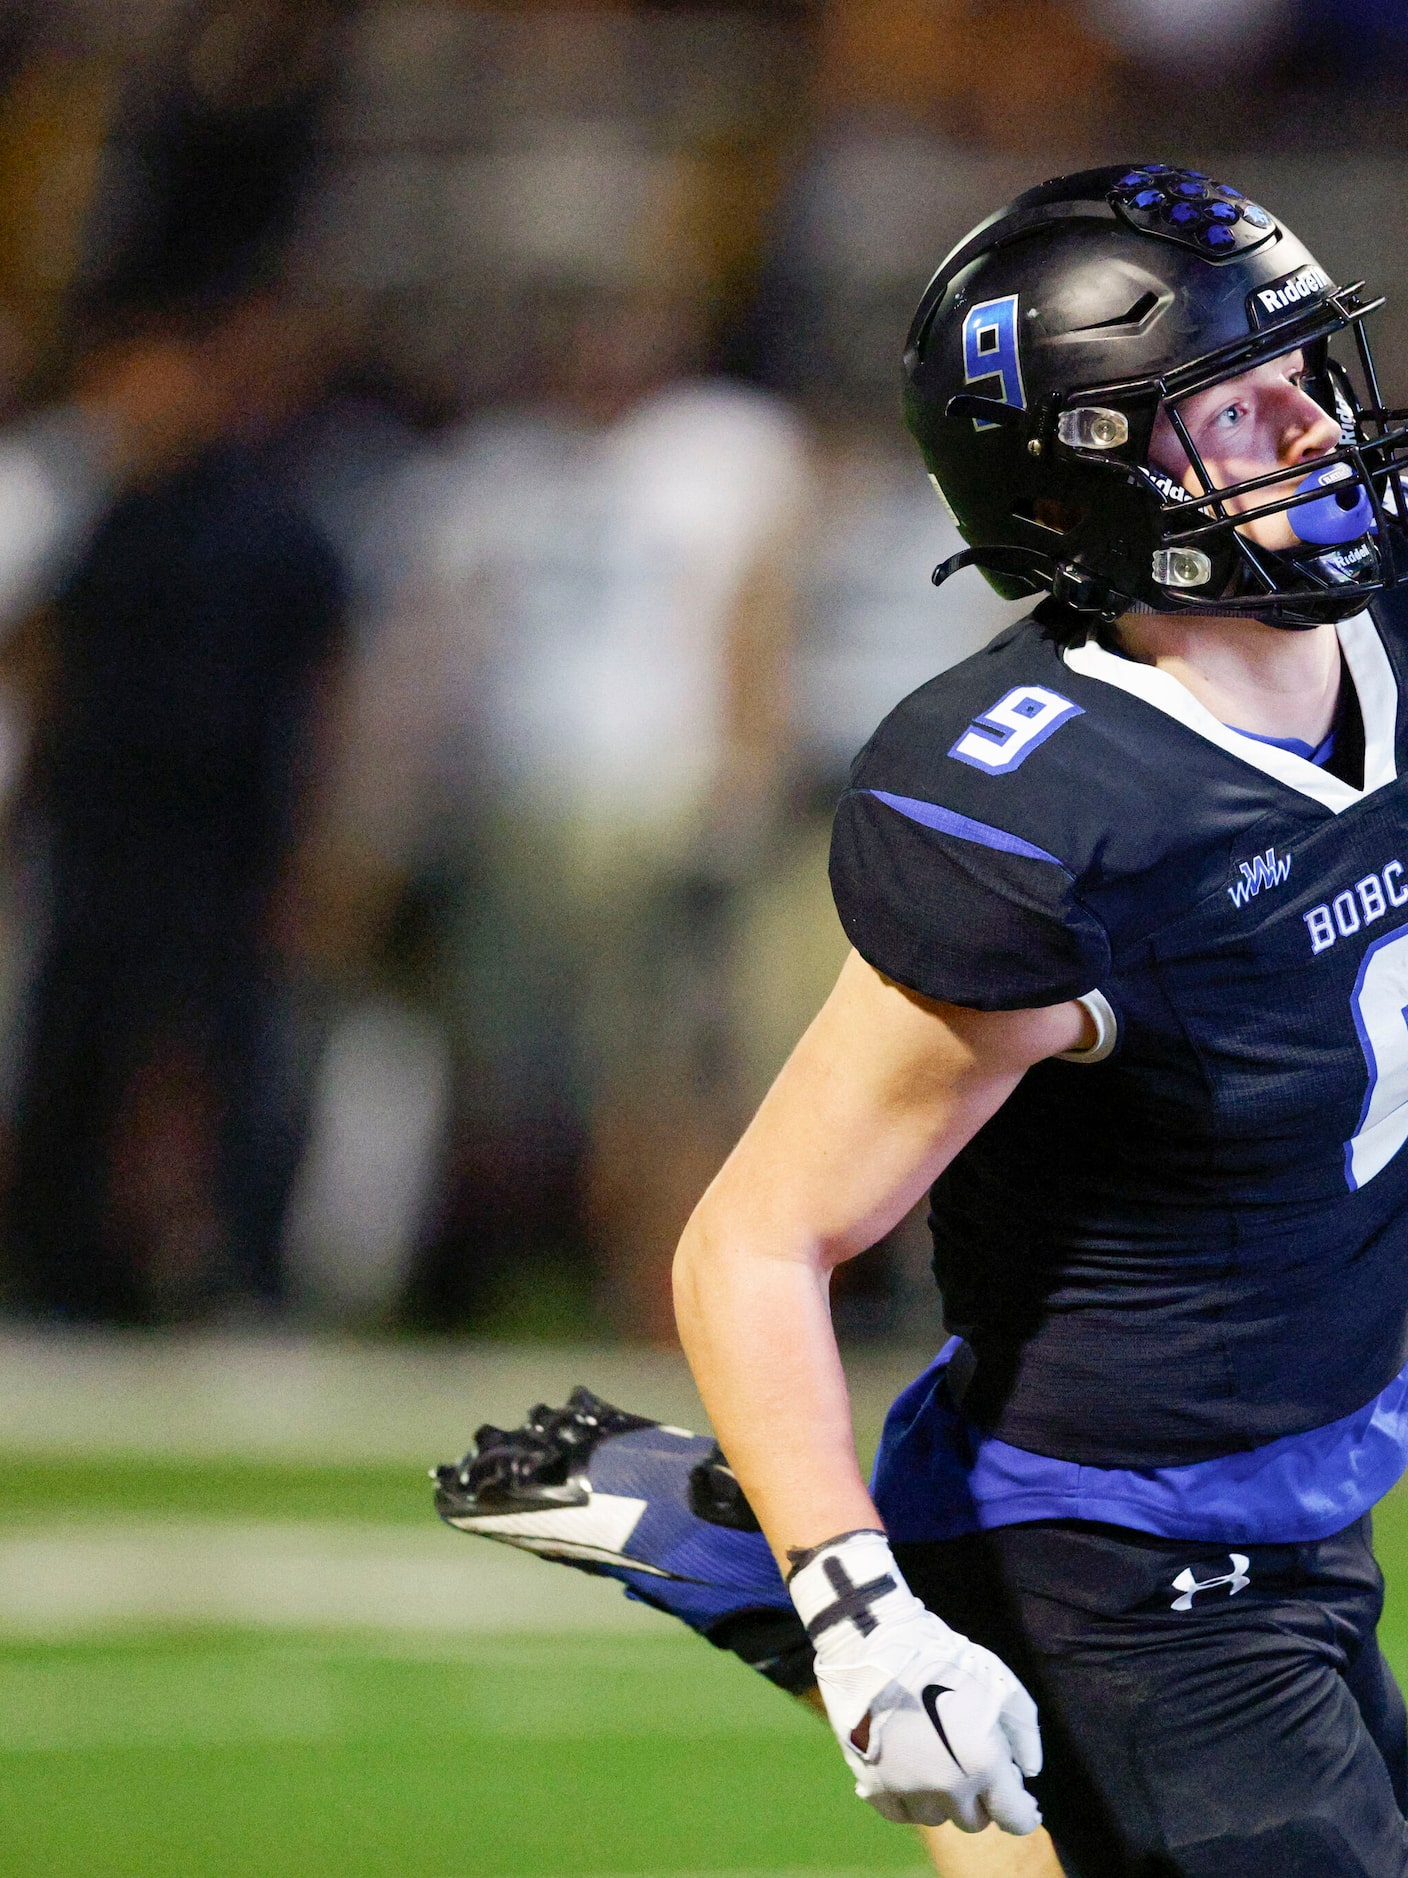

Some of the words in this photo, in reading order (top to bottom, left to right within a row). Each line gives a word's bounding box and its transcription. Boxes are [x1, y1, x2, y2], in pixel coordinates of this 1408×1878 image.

[1257, 268, 1328, 313] Riddell
[961, 293, 1028, 433] 9
[1334, 543, 1370, 569] Riddell
[946, 684, 1087, 777] 9
